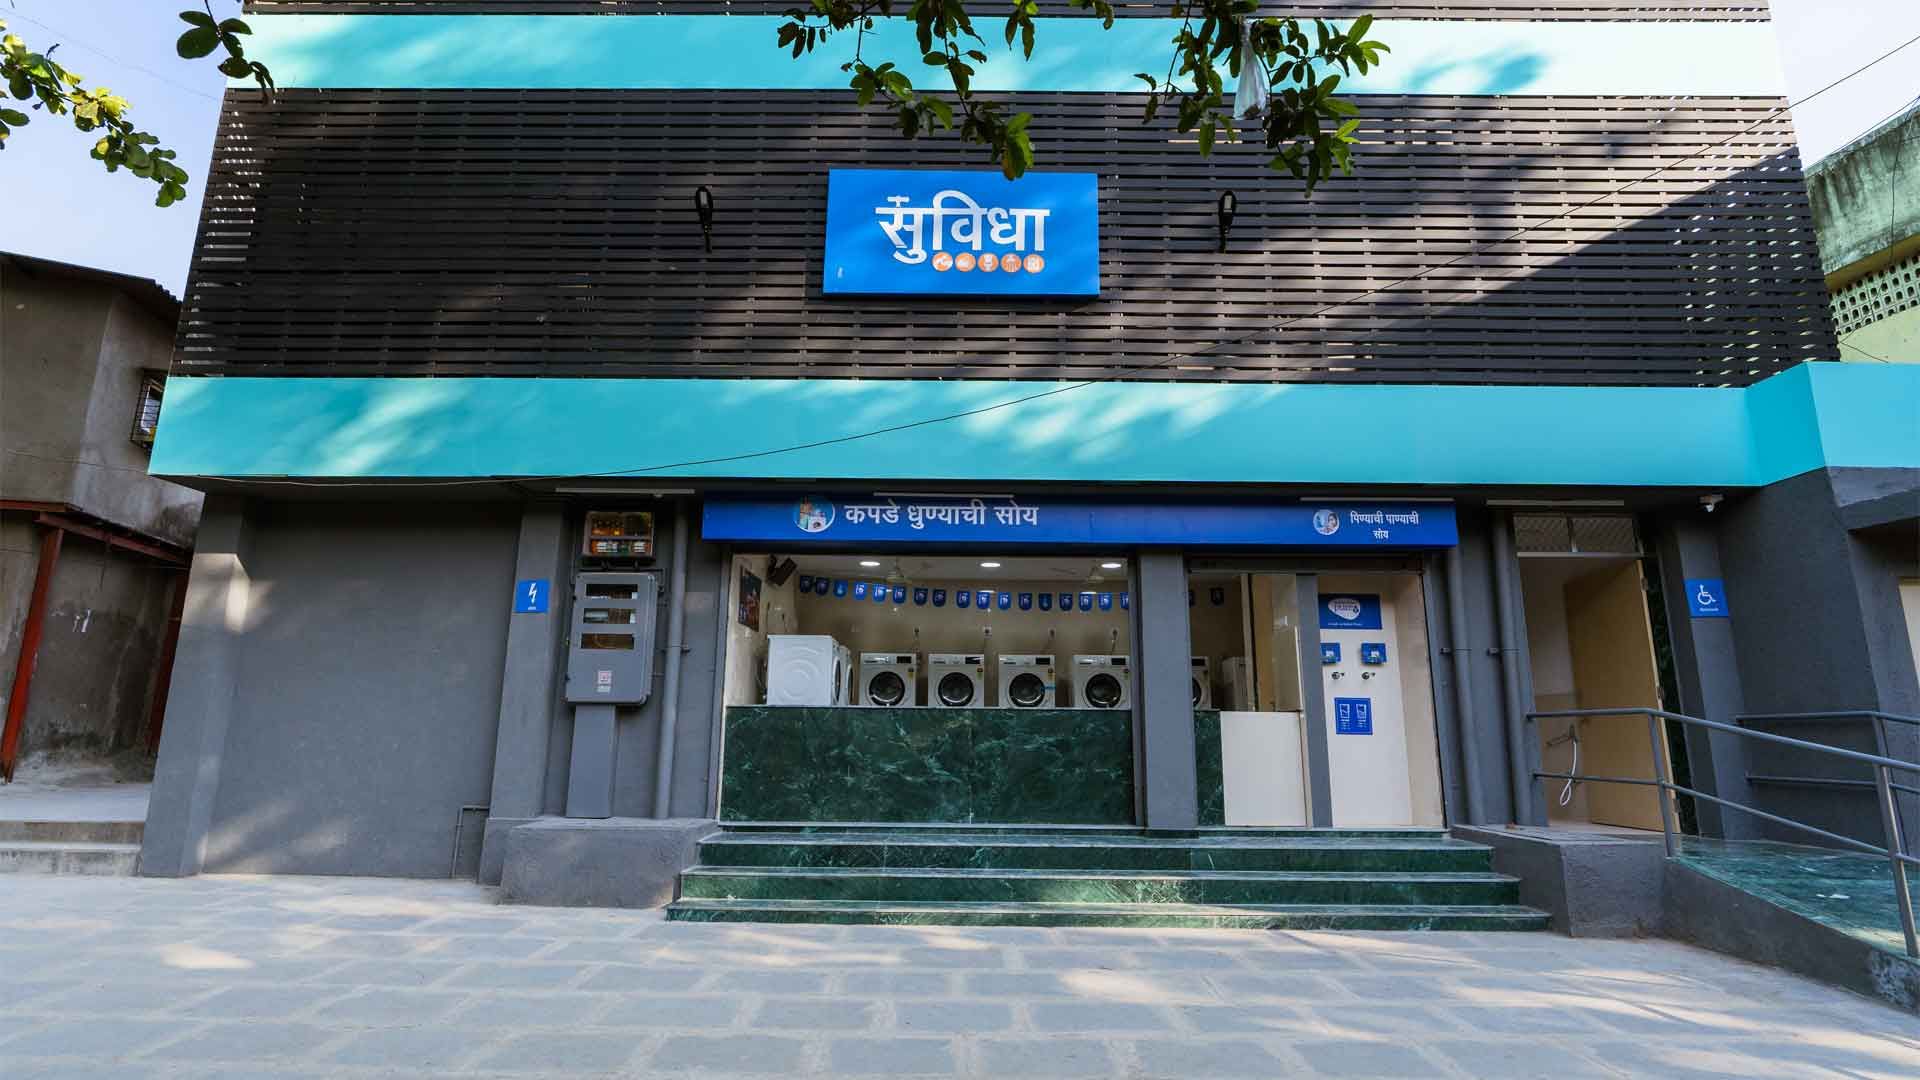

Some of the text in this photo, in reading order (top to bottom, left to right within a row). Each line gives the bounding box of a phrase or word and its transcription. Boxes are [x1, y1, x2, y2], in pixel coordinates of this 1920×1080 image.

[875, 190, 1051, 264] सुविधा
[844, 499, 1039, 529] कपडे धुण्याची सोय
[1351, 511, 1419, 525] पिण्याची पाण्याची
[1372, 528, 1389, 539] सोय
